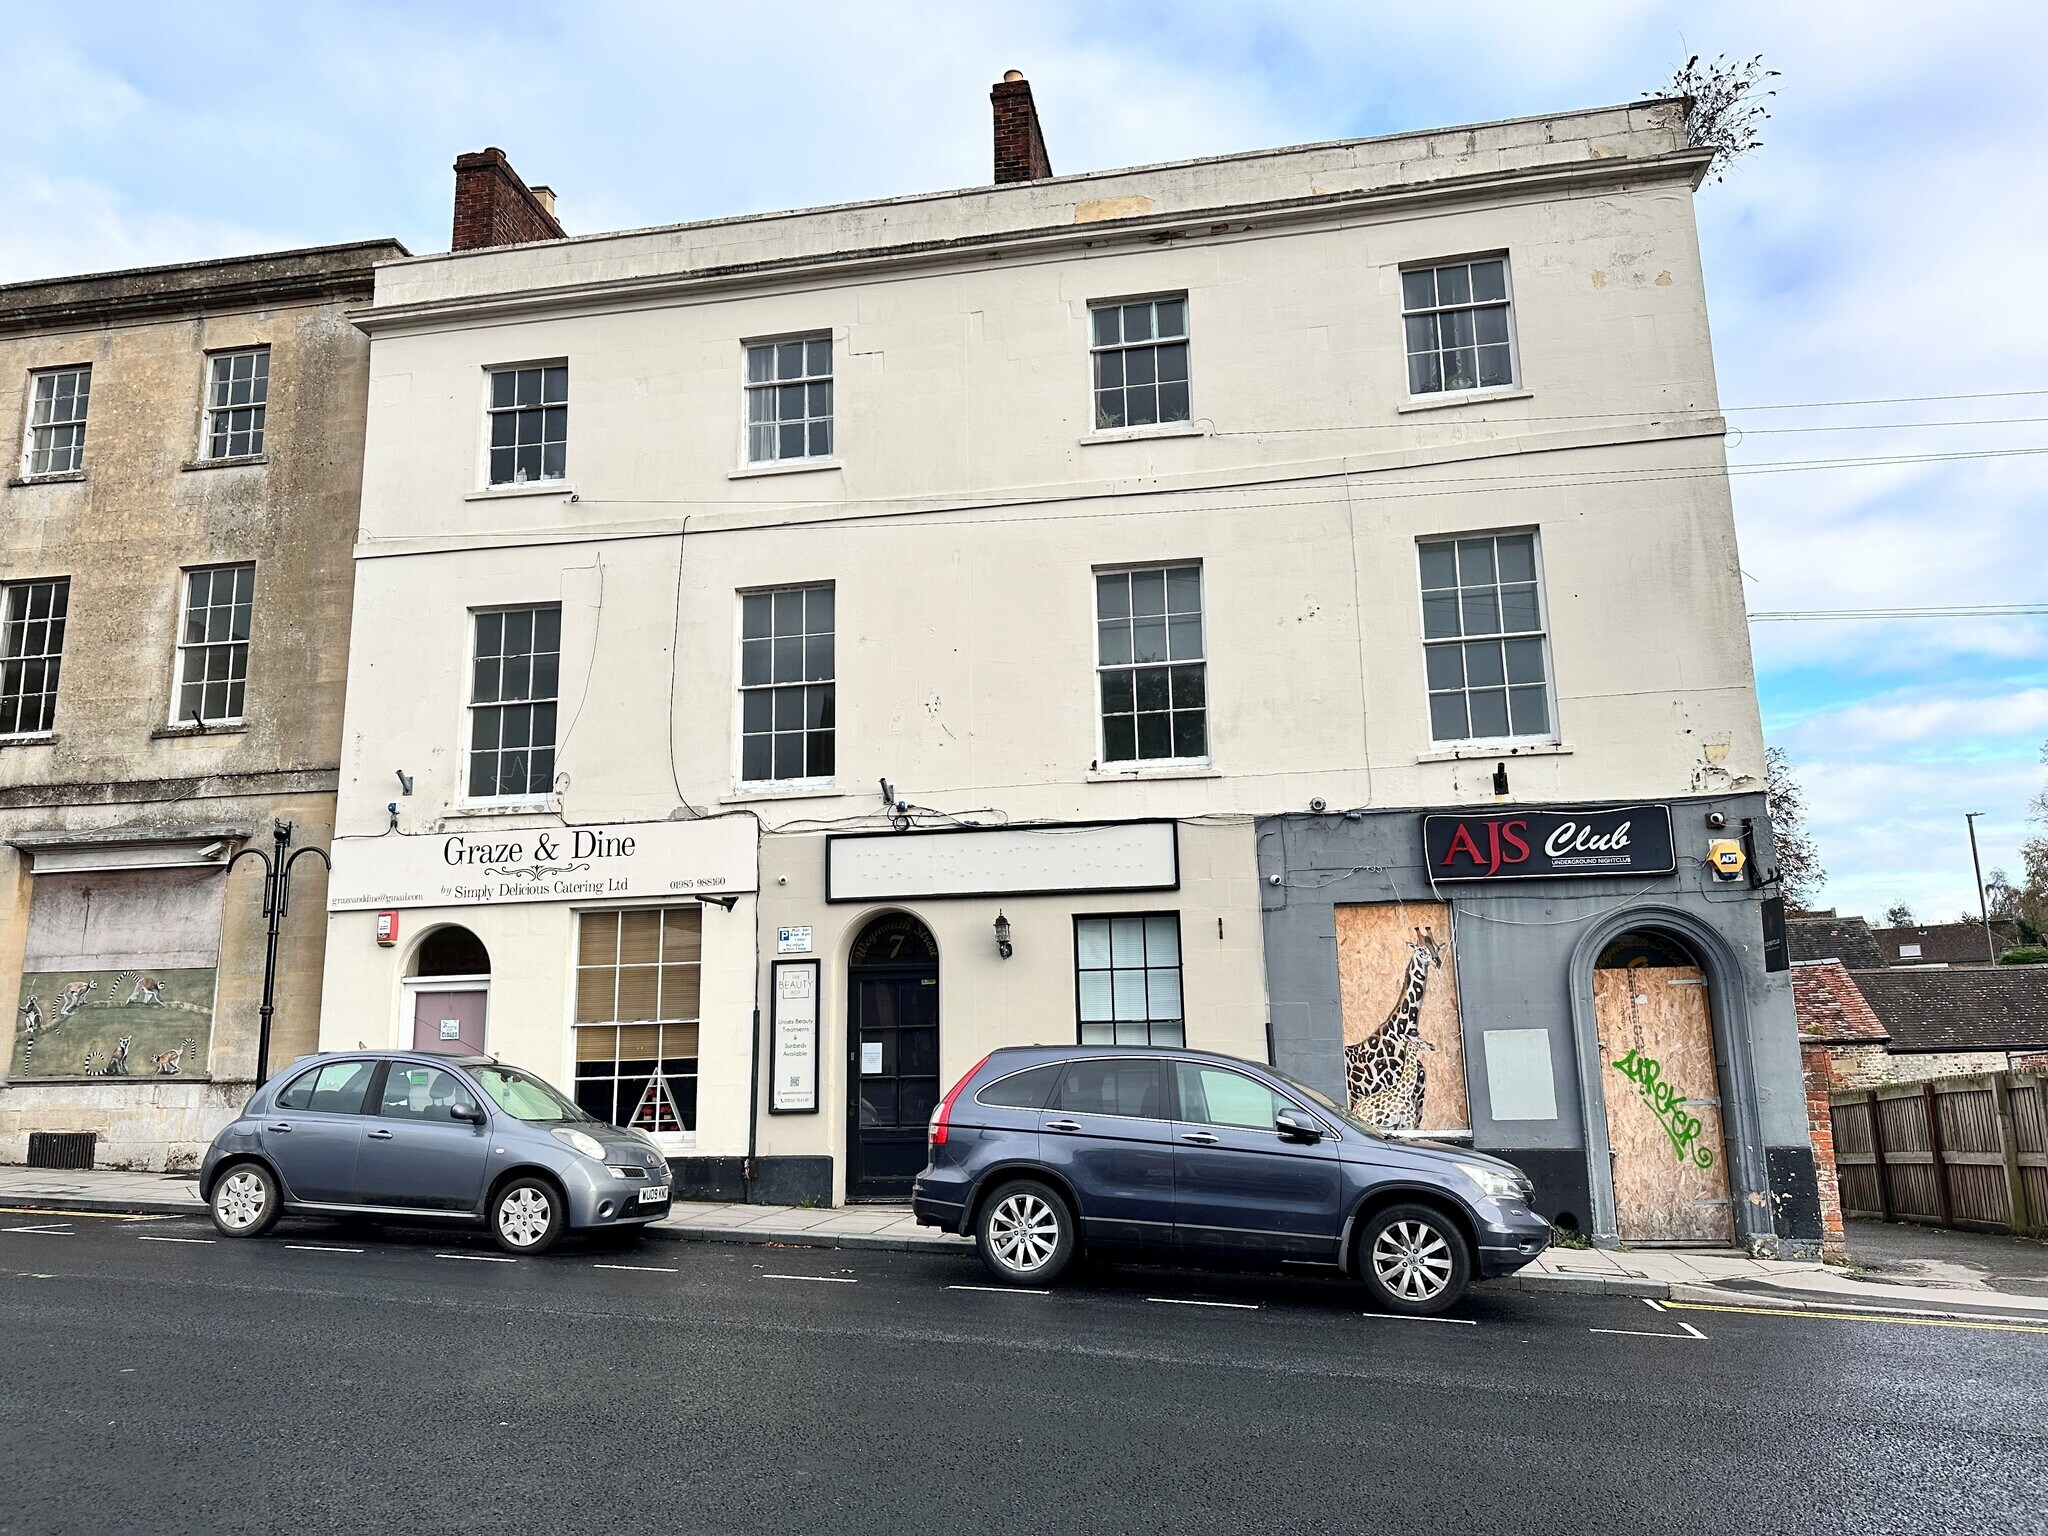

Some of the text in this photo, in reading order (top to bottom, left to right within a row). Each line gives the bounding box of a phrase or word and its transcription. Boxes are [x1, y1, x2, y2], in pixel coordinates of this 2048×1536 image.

[444, 830, 636, 866] Graze & Dine
[1440, 820, 1632, 877] AJS Club
[1720, 854, 1738, 864] ADT
[1551, 856, 1632, 866] UNDERGROUND NIGHTCLUB
[440, 878, 628, 901] by Simply Delicious Catering Ltd
[670, 877, 726, 890] 01985 988160
[855, 917, 939, 959] Weymouth Street
[890, 934, 906, 958] 7
[778, 980, 813, 990] BEAUTY
